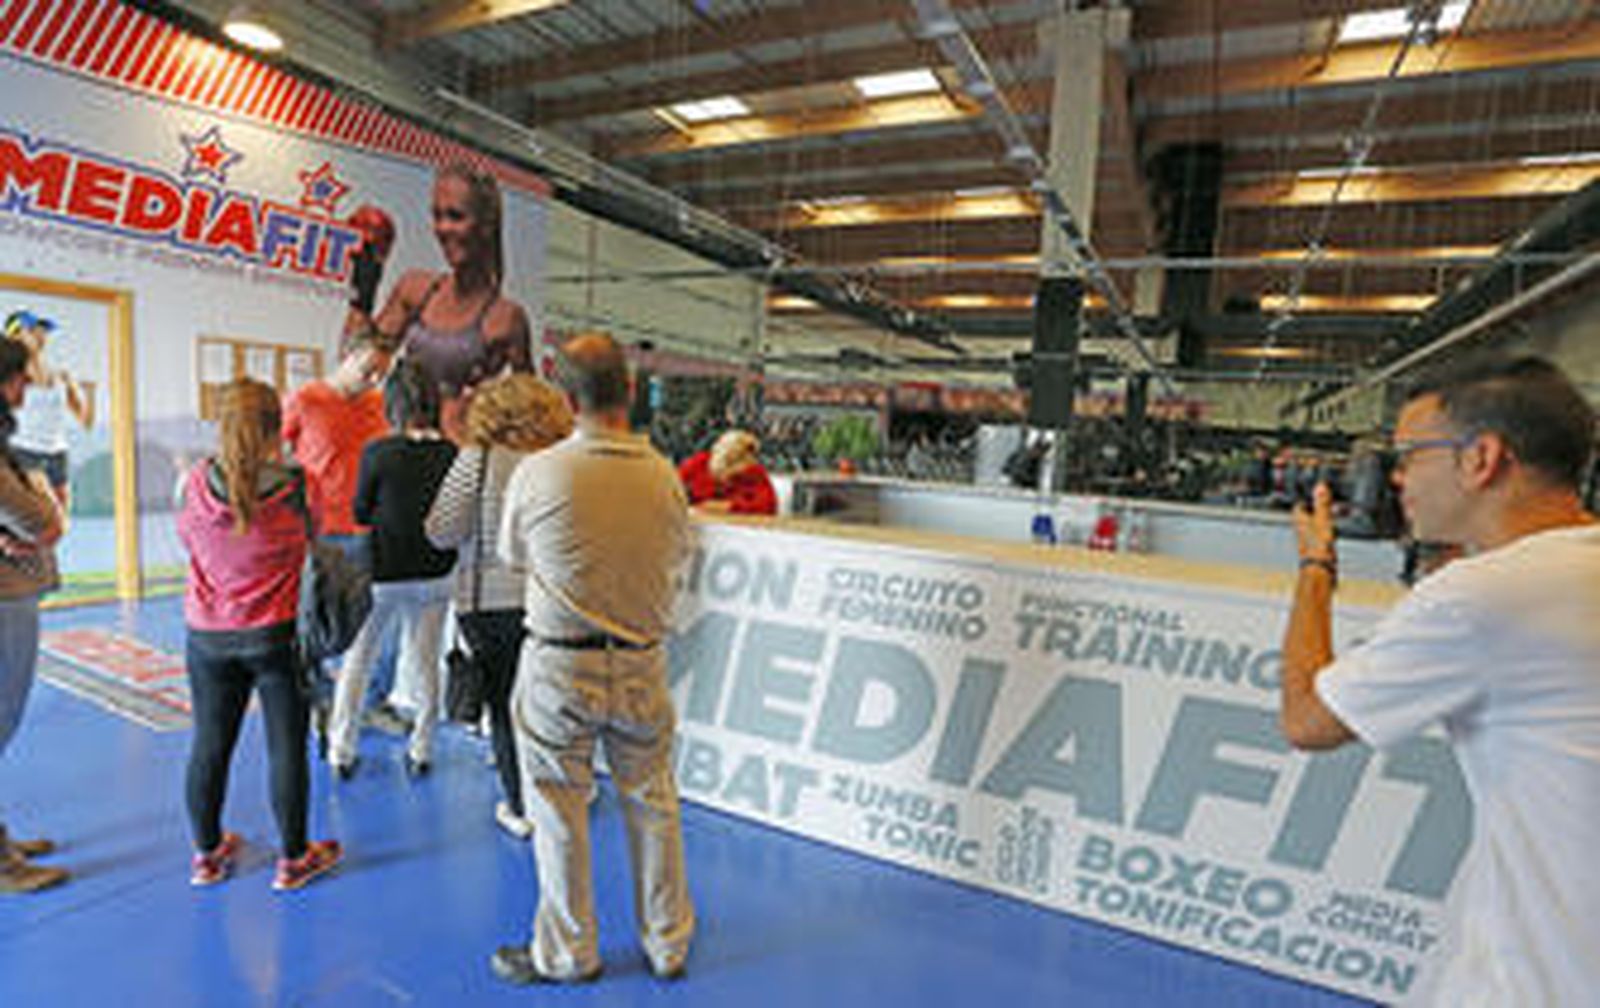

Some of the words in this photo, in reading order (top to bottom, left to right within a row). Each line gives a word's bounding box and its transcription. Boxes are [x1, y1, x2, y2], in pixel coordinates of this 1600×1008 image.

[0, 132, 362, 281] MEDIAFIT
[676, 546, 797, 610] ION
[827, 567, 984, 611] CIRCUITO
[821, 597, 987, 642] FEMENINO
[1020, 594, 1185, 631] FUNCTIONAL
[675, 733, 820, 818] BAT
[830, 773, 959, 826] ZUMBA
[864, 813, 981, 868] TONIC
[1076, 834, 1295, 919] BOXEO
[1074, 877, 1417, 995] TONIFICACION
[1307, 905, 1440, 954] COMBAT
